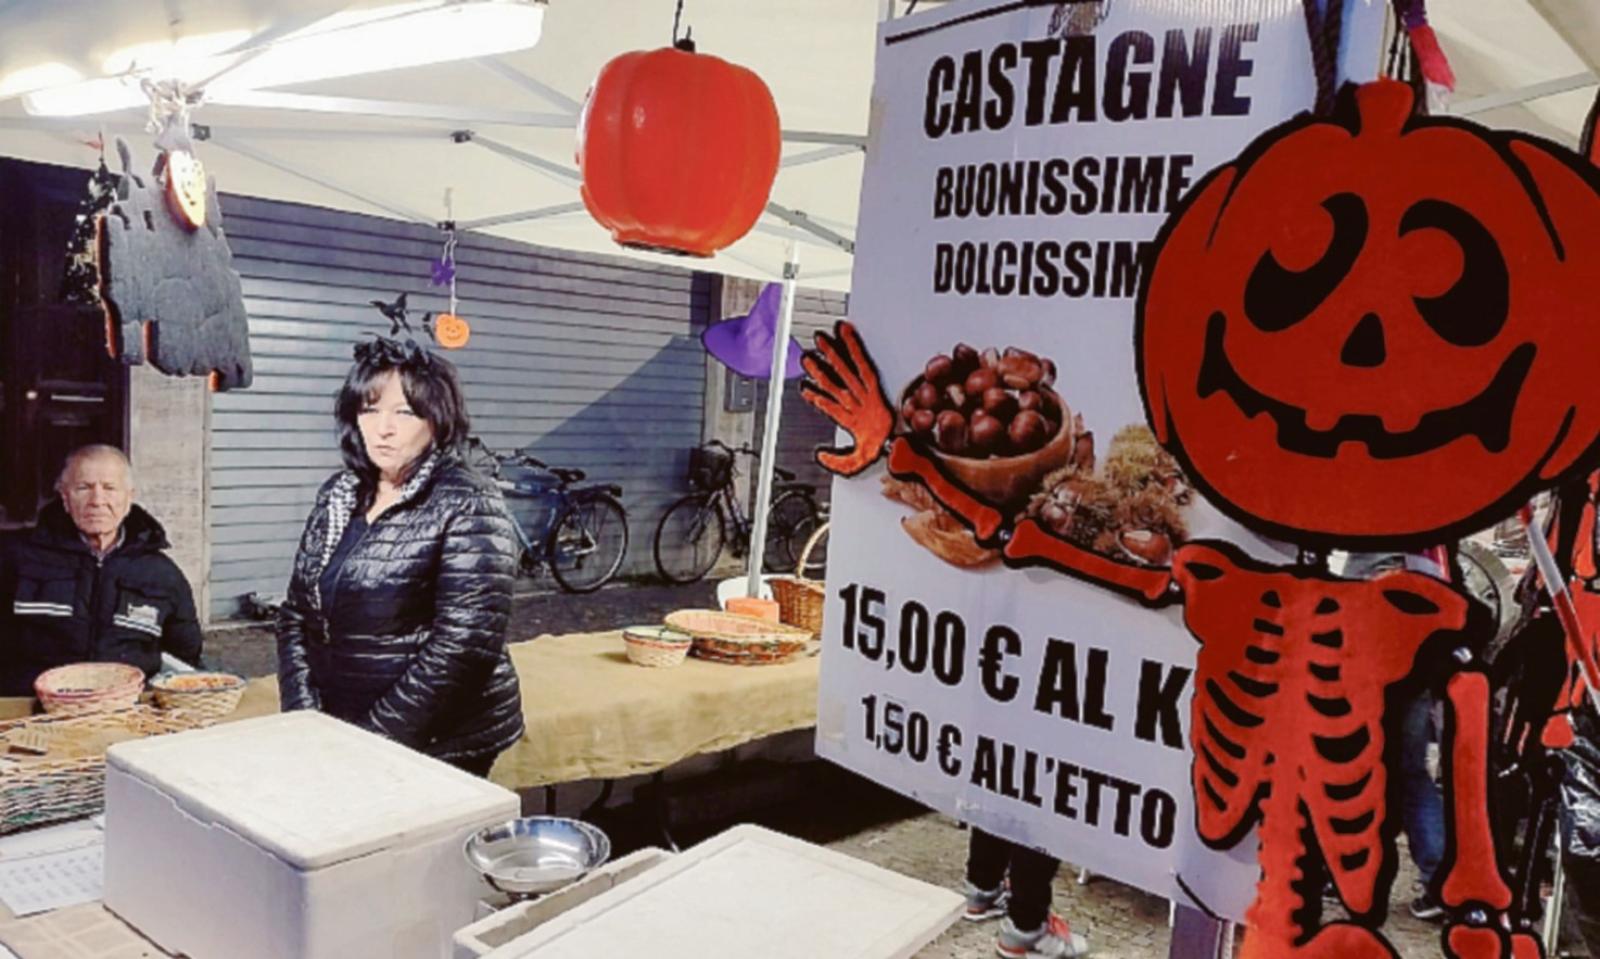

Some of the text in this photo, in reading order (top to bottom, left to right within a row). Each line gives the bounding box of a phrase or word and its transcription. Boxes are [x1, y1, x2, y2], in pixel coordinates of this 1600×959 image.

[924, 23, 1259, 138] CASTAGNE
[934, 155, 1193, 218] BUONISSIME
[838, 583, 966, 686] 15,00
[978, 625, 1022, 702] €
[1034, 638, 1114, 731] AL
[862, 694, 1176, 849] 1,50 € ALL'ETTO
